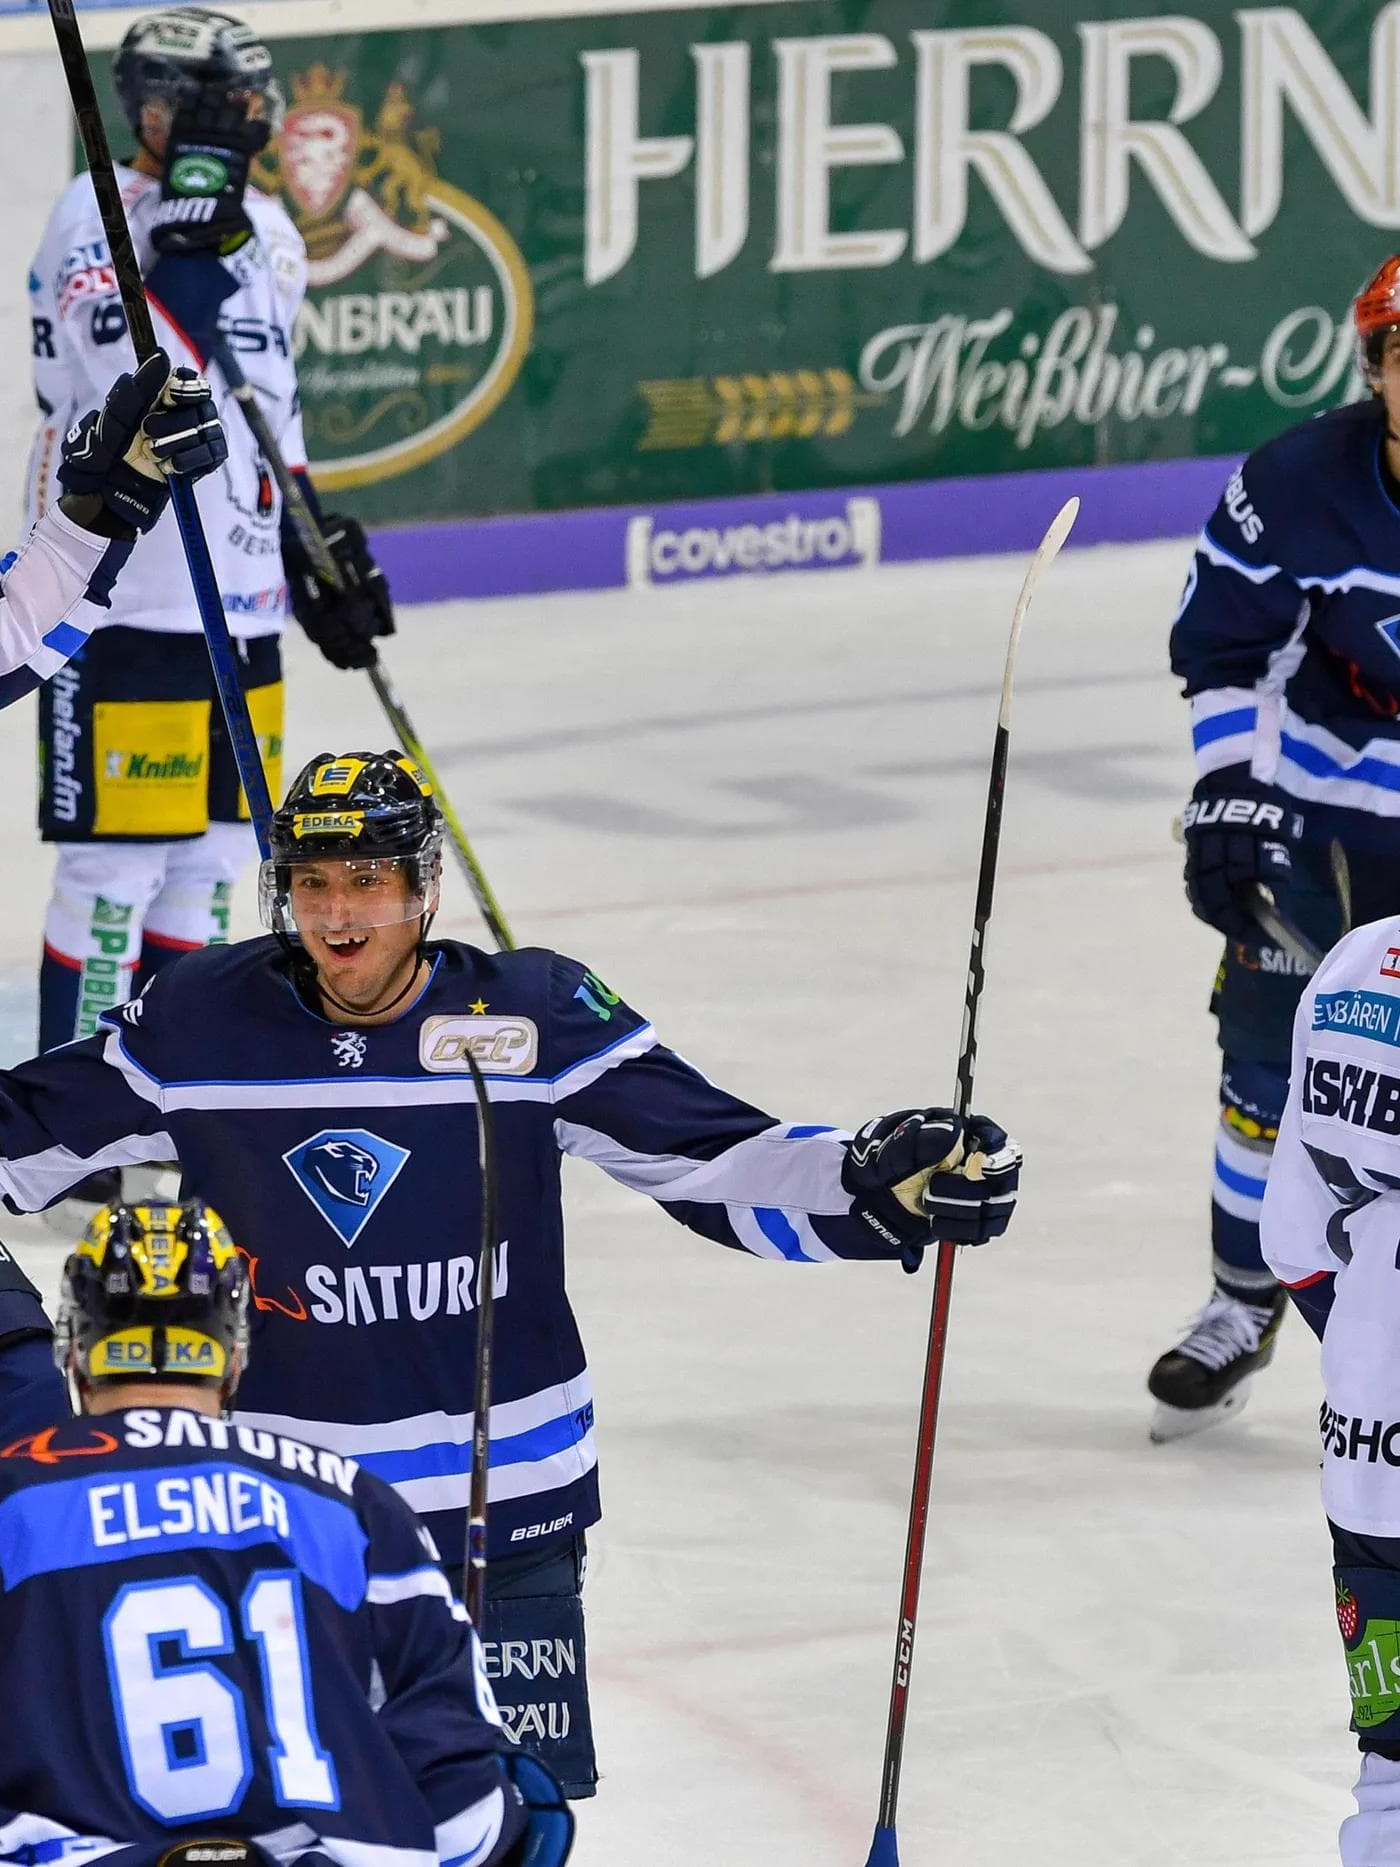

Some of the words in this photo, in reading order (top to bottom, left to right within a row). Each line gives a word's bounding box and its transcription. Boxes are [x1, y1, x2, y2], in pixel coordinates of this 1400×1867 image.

[578, 3, 1400, 287] HERRN
[302, 817, 355, 827] EDEKA
[862, 1210, 901, 1246] BAUER
[305, 1240, 509, 1326] SATURN
[107, 1342, 214, 1363] EDKA
[123, 1408, 359, 1496] SATURN
[87, 1471, 290, 1546] ELSNER
[511, 1512, 573, 1541] BAUER
[897, 1617, 913, 1687] CCM
[102, 1567, 341, 1827] 61
[183, 1847, 248, 1864] BAUER
